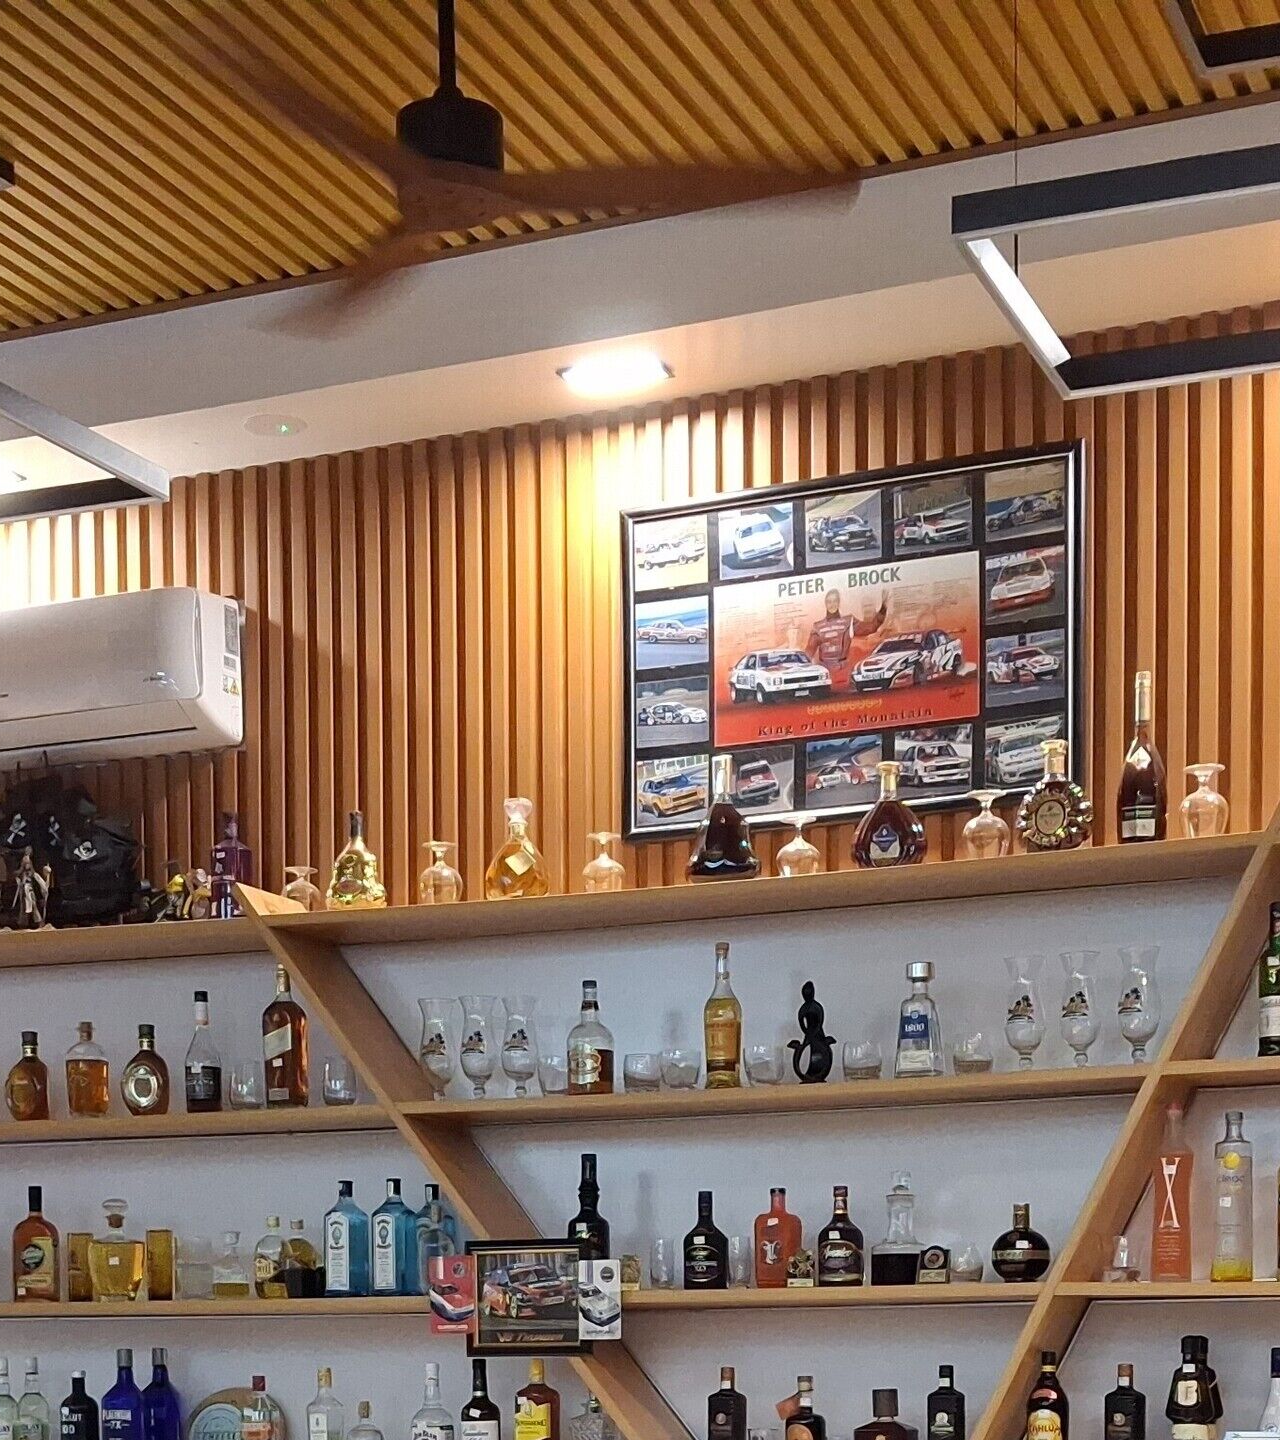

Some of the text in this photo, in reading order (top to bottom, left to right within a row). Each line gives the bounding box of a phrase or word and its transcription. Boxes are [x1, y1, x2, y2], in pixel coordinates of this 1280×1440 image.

[778, 566, 902, 597] PETER BROCK
[758, 707, 934, 737] King of the Mountain
